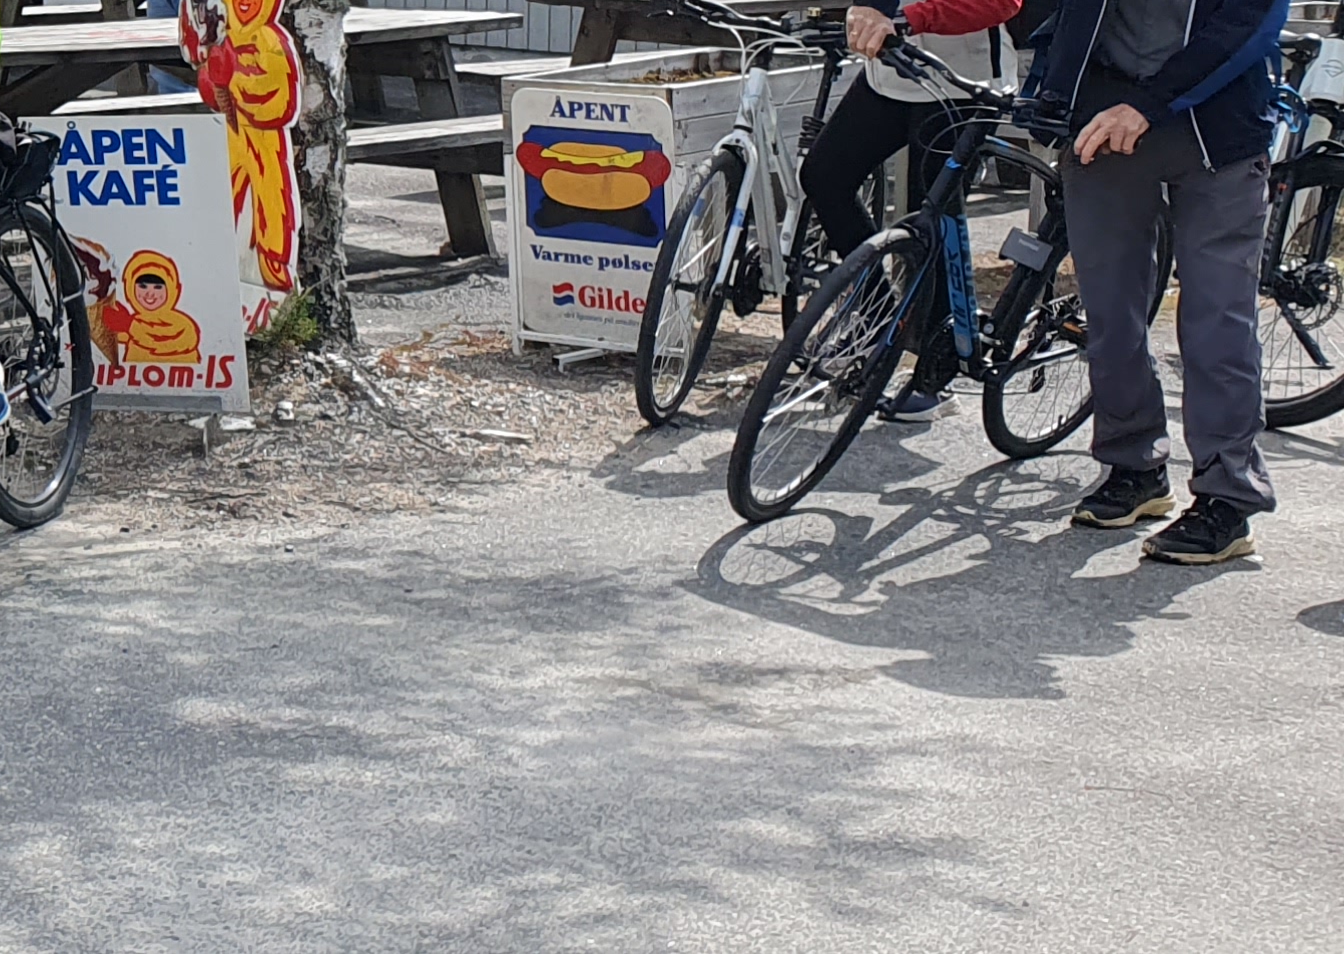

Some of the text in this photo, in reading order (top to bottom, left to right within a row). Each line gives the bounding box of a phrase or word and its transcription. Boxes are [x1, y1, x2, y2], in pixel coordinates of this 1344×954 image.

[550, 96, 631, 123] ÅPENT
[56, 121, 187, 165] ÅPEN
[66, 164, 181, 206] KAFÉ
[530, 244, 656, 272] Varme pølse
[578, 285, 647, 314] Gilde
[95, 355, 235, 389] IPLOM-IS
